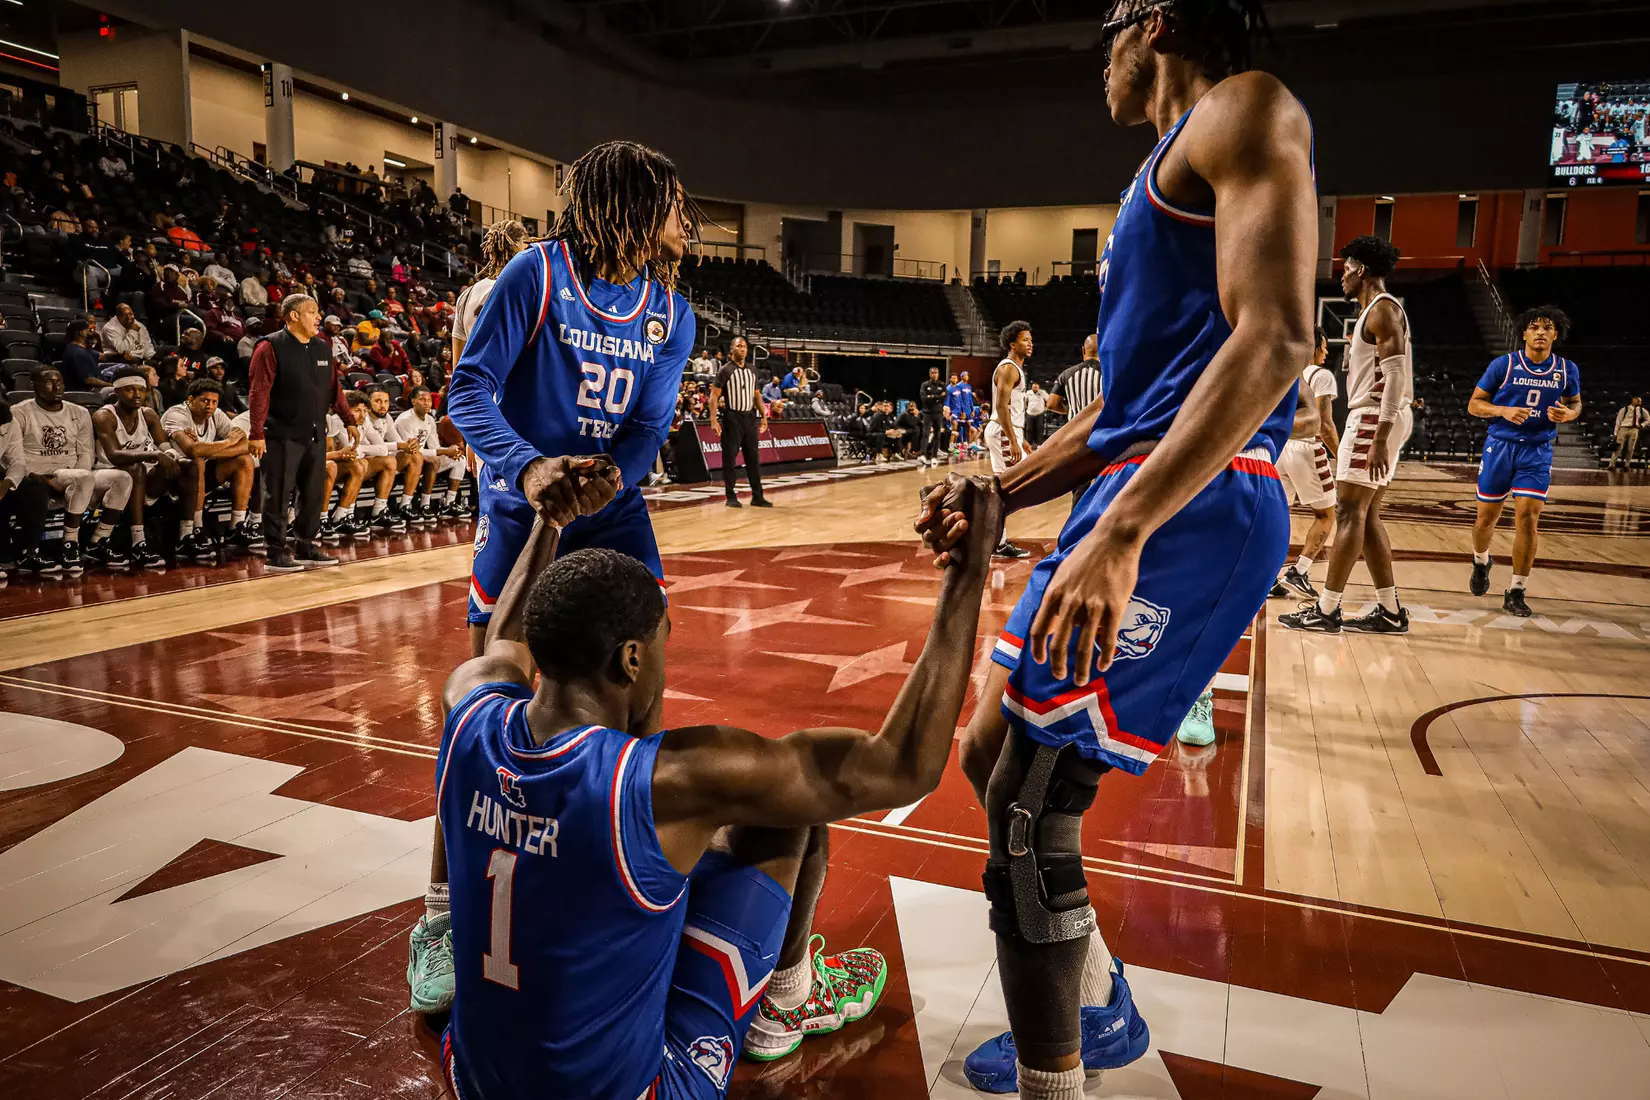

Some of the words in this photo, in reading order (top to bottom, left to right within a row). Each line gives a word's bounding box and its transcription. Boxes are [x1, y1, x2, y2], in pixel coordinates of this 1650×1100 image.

[1554, 165, 1596, 176] BULLDOGS
[1568, 177, 1577, 187] 6
[559, 323, 655, 364] LOUISIANA
[576, 361, 635, 414] 20
[1513, 377, 1559, 388] LOUISIANA
[1526, 389, 1541, 407] 0
[466, 790, 559, 858] HUNTER
[482, 847, 520, 991] 1
